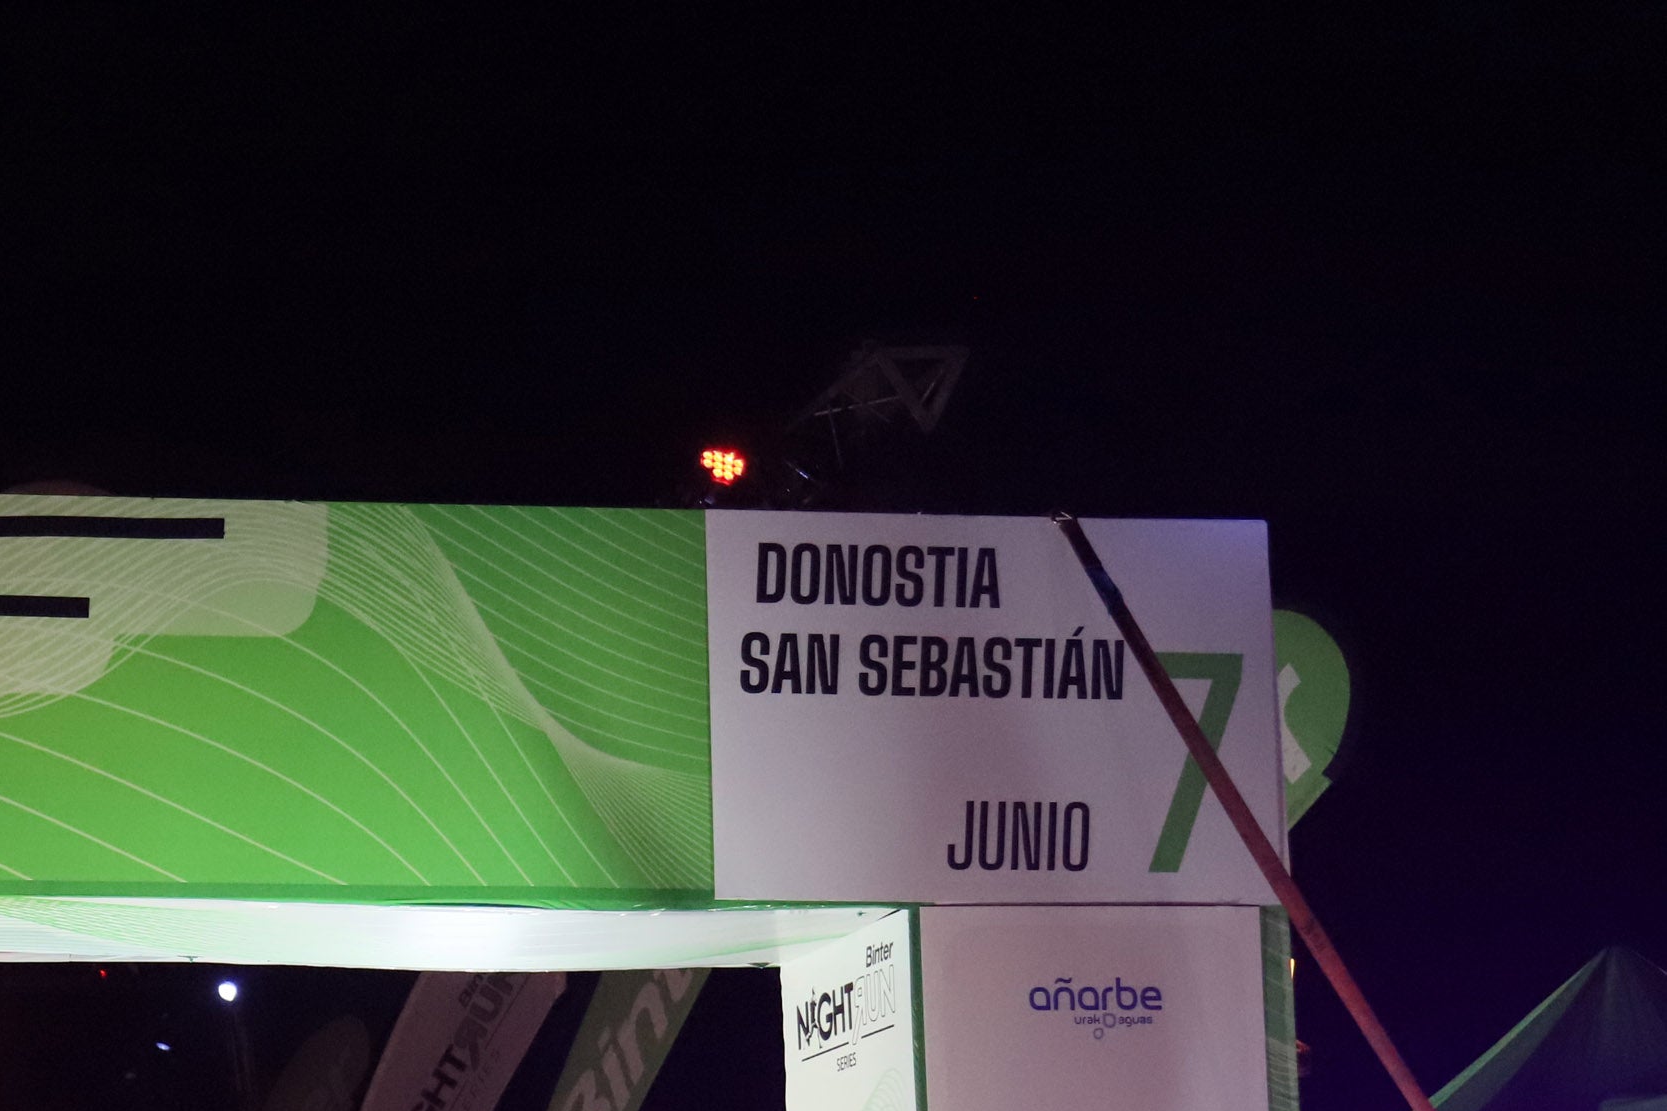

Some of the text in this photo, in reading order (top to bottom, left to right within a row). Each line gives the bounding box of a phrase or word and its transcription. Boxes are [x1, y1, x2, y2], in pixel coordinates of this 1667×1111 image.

[755, 541, 1001, 609] DONOSTIA
[739, 626, 1125, 700] SAN SEBASTIÁN
[1146, 651, 1244, 874] 7
[946, 800, 1090, 872] JUNIO
[865, 941, 894, 968] Binter
[1028, 977, 1163, 1011] añarbe
[1074, 1014, 1153, 1027] urak aguas
[836, 1052, 857, 1072] SERIES
